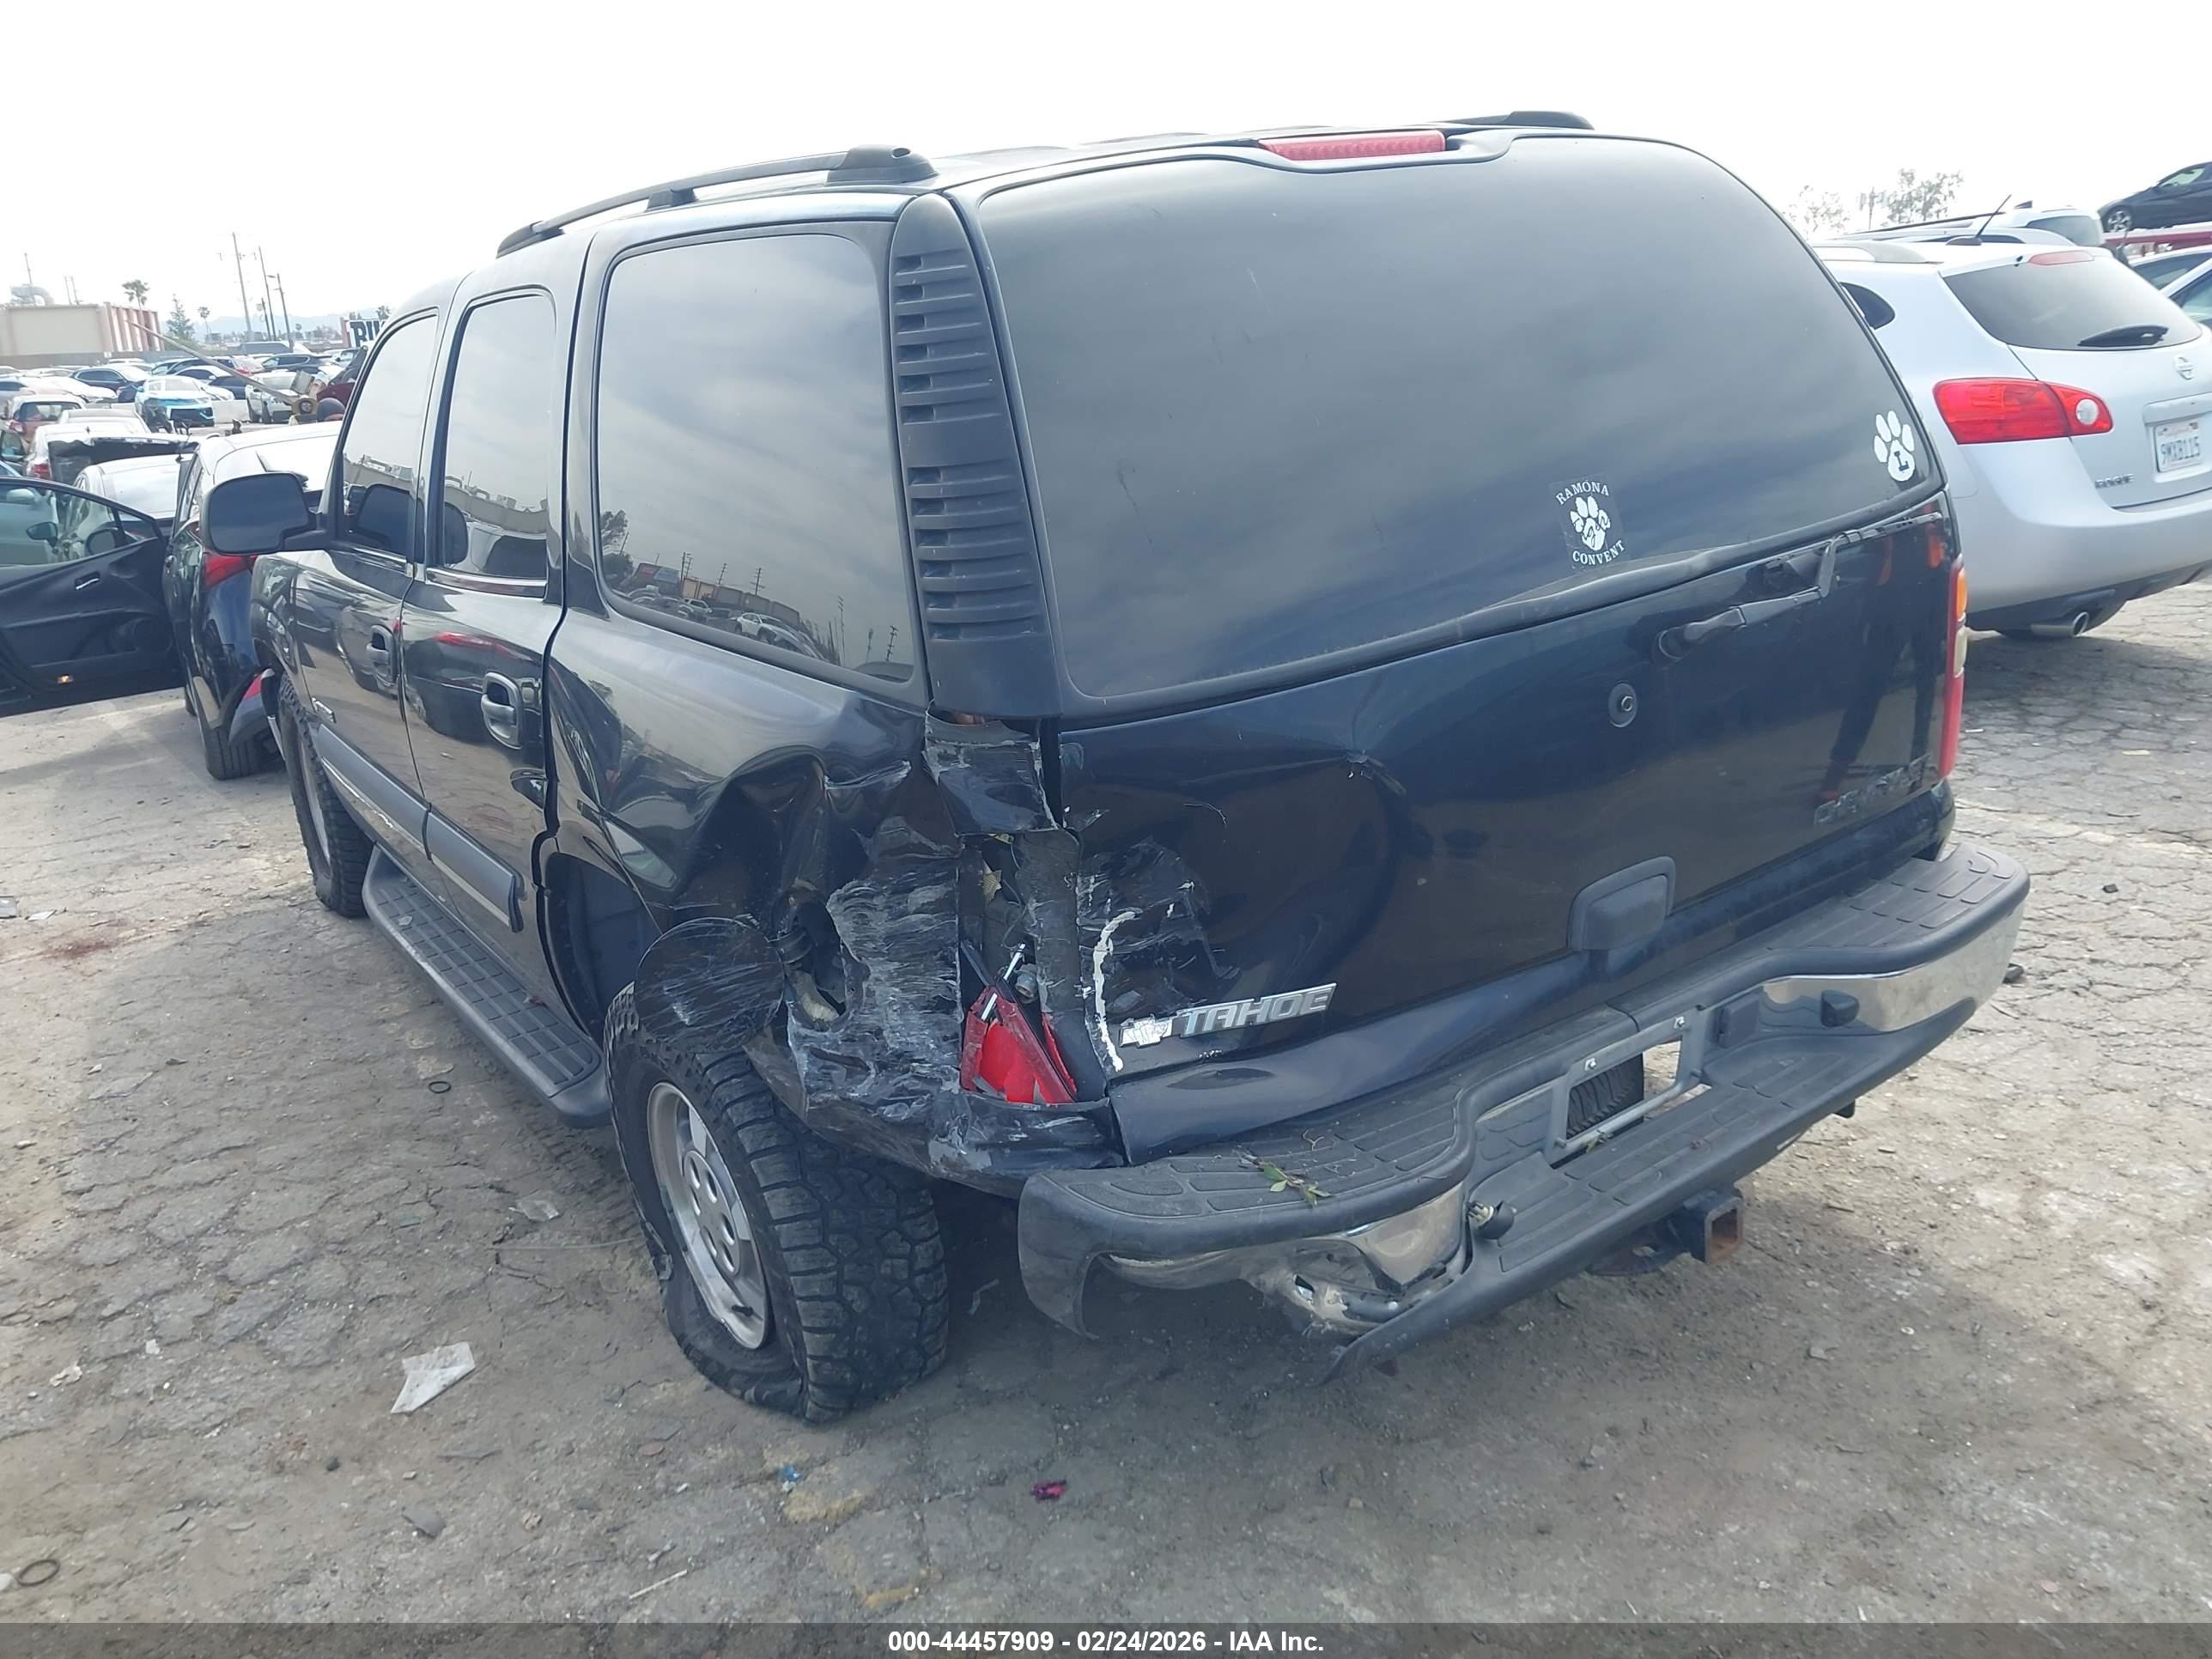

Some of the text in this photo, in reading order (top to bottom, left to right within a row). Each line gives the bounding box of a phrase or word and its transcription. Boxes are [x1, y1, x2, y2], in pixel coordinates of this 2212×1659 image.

[1893, 451, 1910, 471] L
[1555, 481, 1609, 506] RAMONA
[1572, 539, 1625, 565] CONVENT
[1179, 985, 1336, 1038] TAHOE
